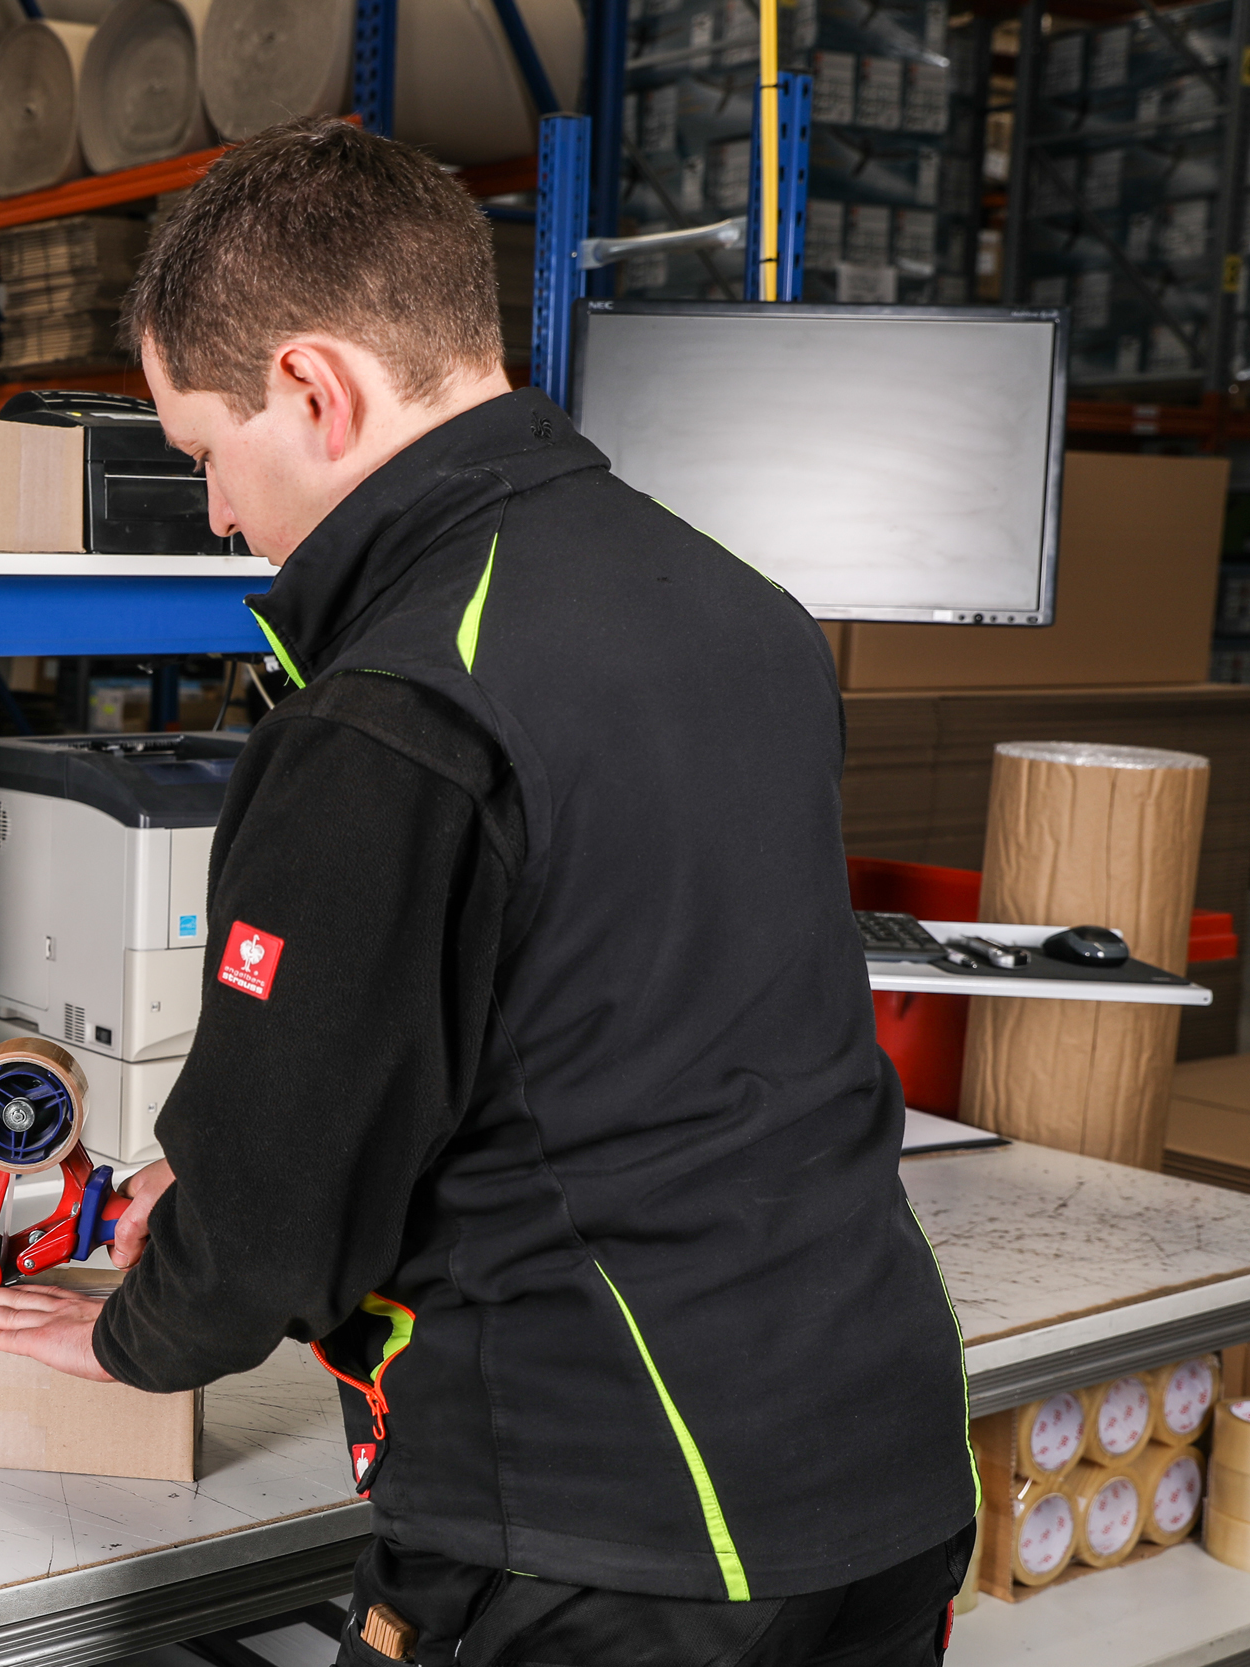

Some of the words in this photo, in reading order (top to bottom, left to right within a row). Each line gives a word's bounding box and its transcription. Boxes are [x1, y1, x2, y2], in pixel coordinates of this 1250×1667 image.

[588, 301, 615, 310] NEC
[222, 972, 263, 994] strauss
[224, 966, 265, 987] engelbert
